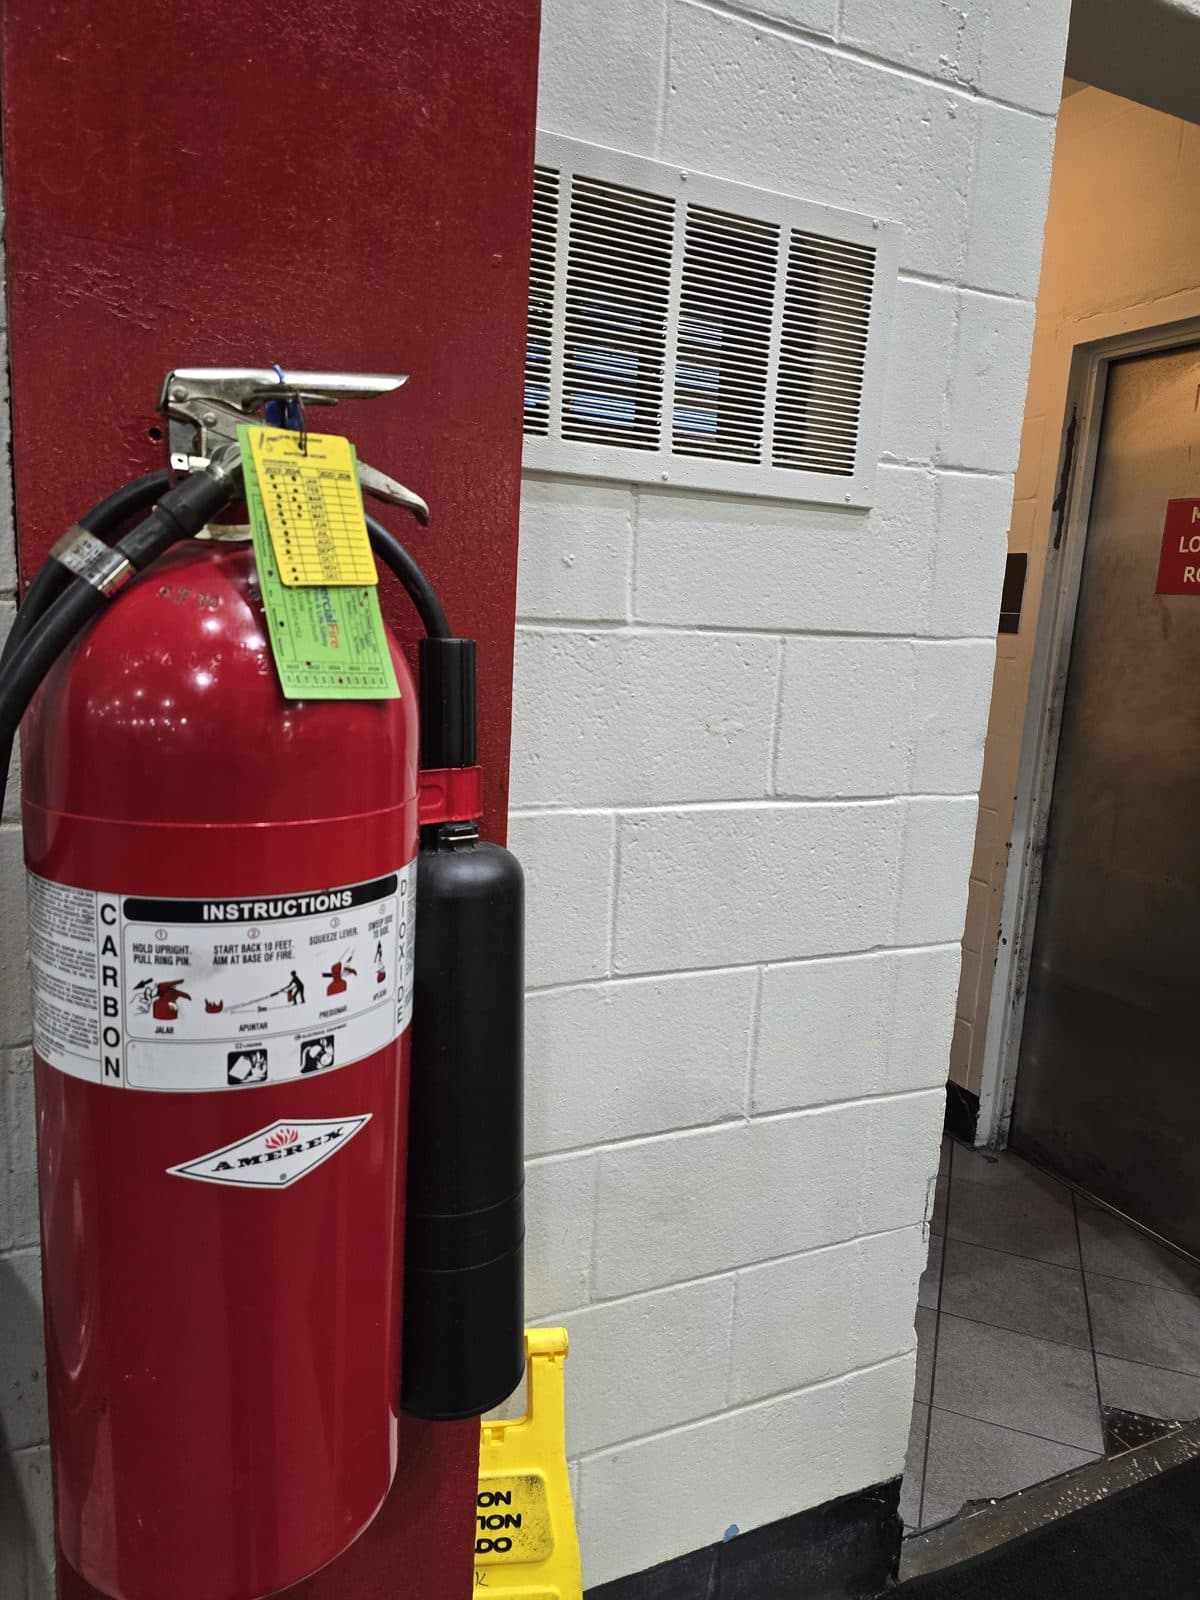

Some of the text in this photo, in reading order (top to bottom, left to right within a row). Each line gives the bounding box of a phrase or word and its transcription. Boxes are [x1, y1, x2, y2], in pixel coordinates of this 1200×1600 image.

[203, 890, 353, 920] INSTRUCTIONS
[309, 931, 338, 946] SQUEEZE
[132, 943, 153, 954] HOLD
[213, 944, 239, 955] START
[241, 942, 261, 953] BACK
[264, 941, 273, 952] 10
[397, 879, 408, 1024] DIOXIDE
[133, 954, 152, 965] PULL
[154, 955, 174, 966] RING
[212, 955, 228, 966] AIM
[230, 954, 240, 965] AT
[242, 953, 261, 964] BASE
[264, 952, 274, 962] OF
[100, 903, 120, 1078] CARBON
[154, 1025, 174, 1035] JALAR
[238, 1021, 269, 1033] APUNTAR
[211, 1127, 344, 1172] AMEREX
